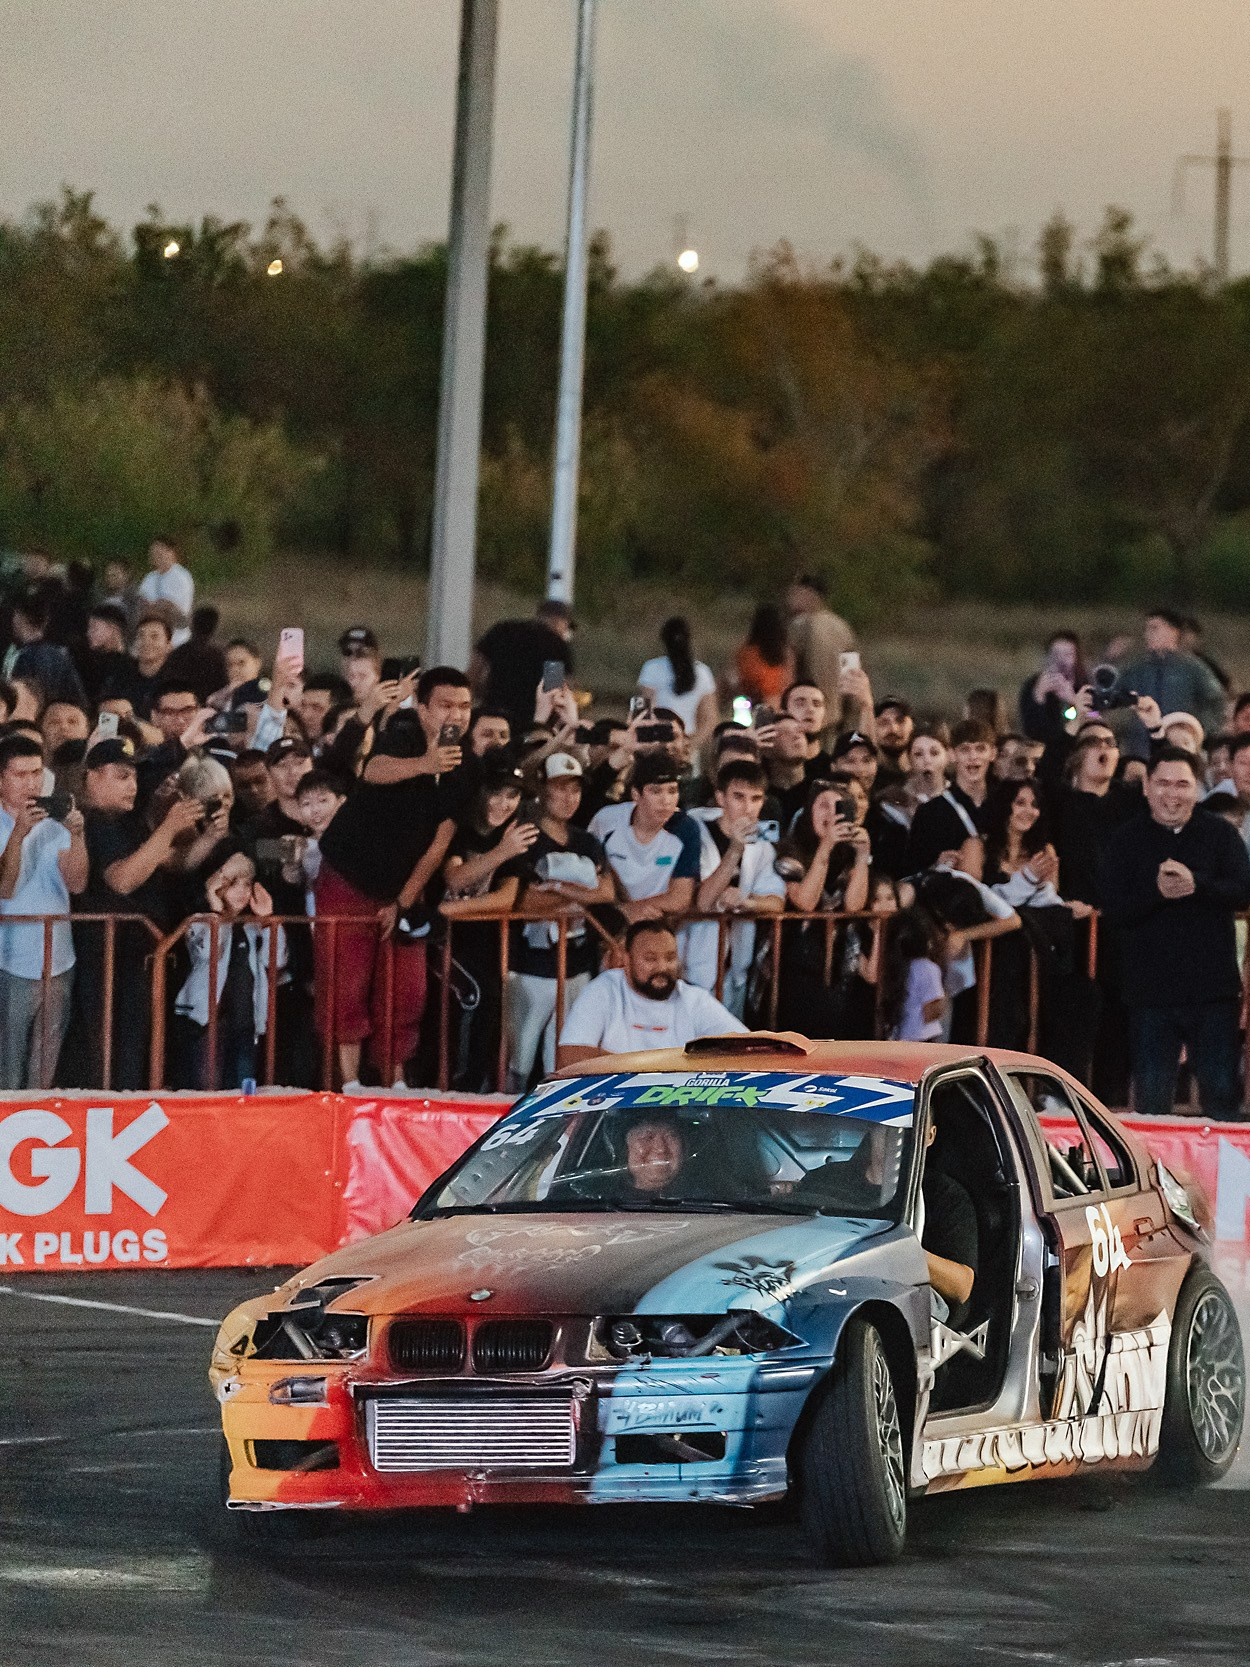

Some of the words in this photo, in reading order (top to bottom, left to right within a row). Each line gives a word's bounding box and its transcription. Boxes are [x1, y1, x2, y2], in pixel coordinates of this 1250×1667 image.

[632, 1085, 767, 1107] DRIFT
[686, 1078, 730, 1087] GORILLA
[480, 1118, 546, 1151] 64
[34, 1229, 168, 1264] PLUGS
[1085, 1203, 1132, 1277] 64
